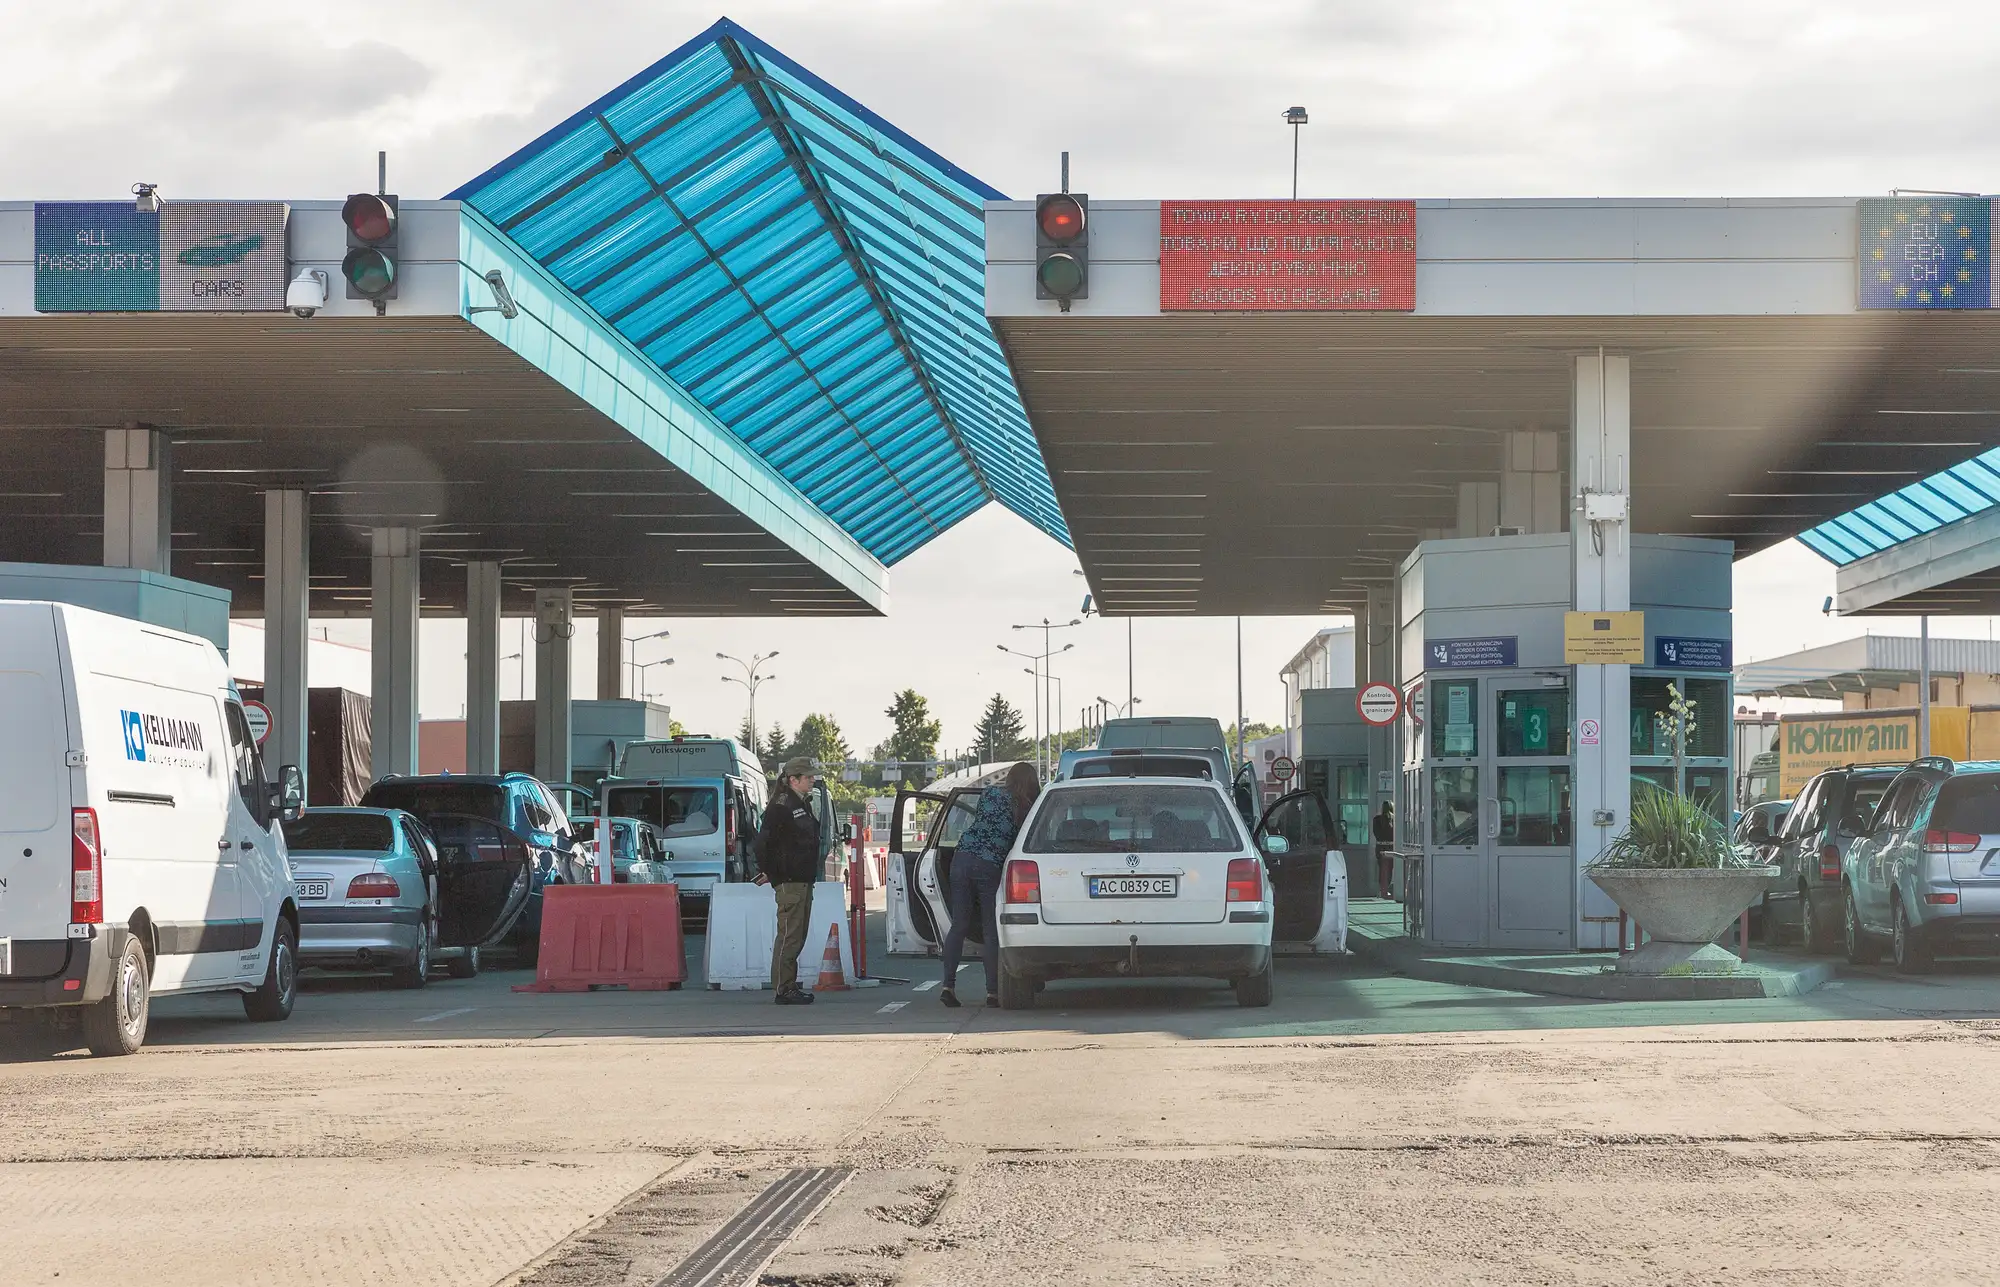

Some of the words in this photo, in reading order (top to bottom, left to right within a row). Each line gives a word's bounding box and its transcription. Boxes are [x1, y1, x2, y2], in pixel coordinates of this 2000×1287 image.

[1172, 209, 1260, 224] TOWARY
[1265, 209, 1292, 224] DO
[76, 229, 111, 246] ALL
[1911, 223, 1938, 240] EU
[1904, 243, 1945, 260] EEA
[38, 253, 154, 272] PASSPORTS
[1911, 264, 1938, 280] CH
[192, 280, 245, 297] CARS
[1191, 288, 1257, 303] GOODS
[1262, 288, 1287, 303] TO
[1292, 288, 1380, 303] DECLARE
[1365, 707, 1393, 715] graniczna
[142, 713, 203, 752] KELLMANN
[1529, 714, 1542, 743] 3
[1631, 714, 1643, 743] 4
[1787, 722, 1909, 755] Holtzmann
[649, 744, 706, 755] Volkswagen
[308, 884, 325, 895] BB
[1099, 880, 1117, 893] AC
[1120, 880, 1149, 893] 0839
[1152, 880, 1171, 893] CE
